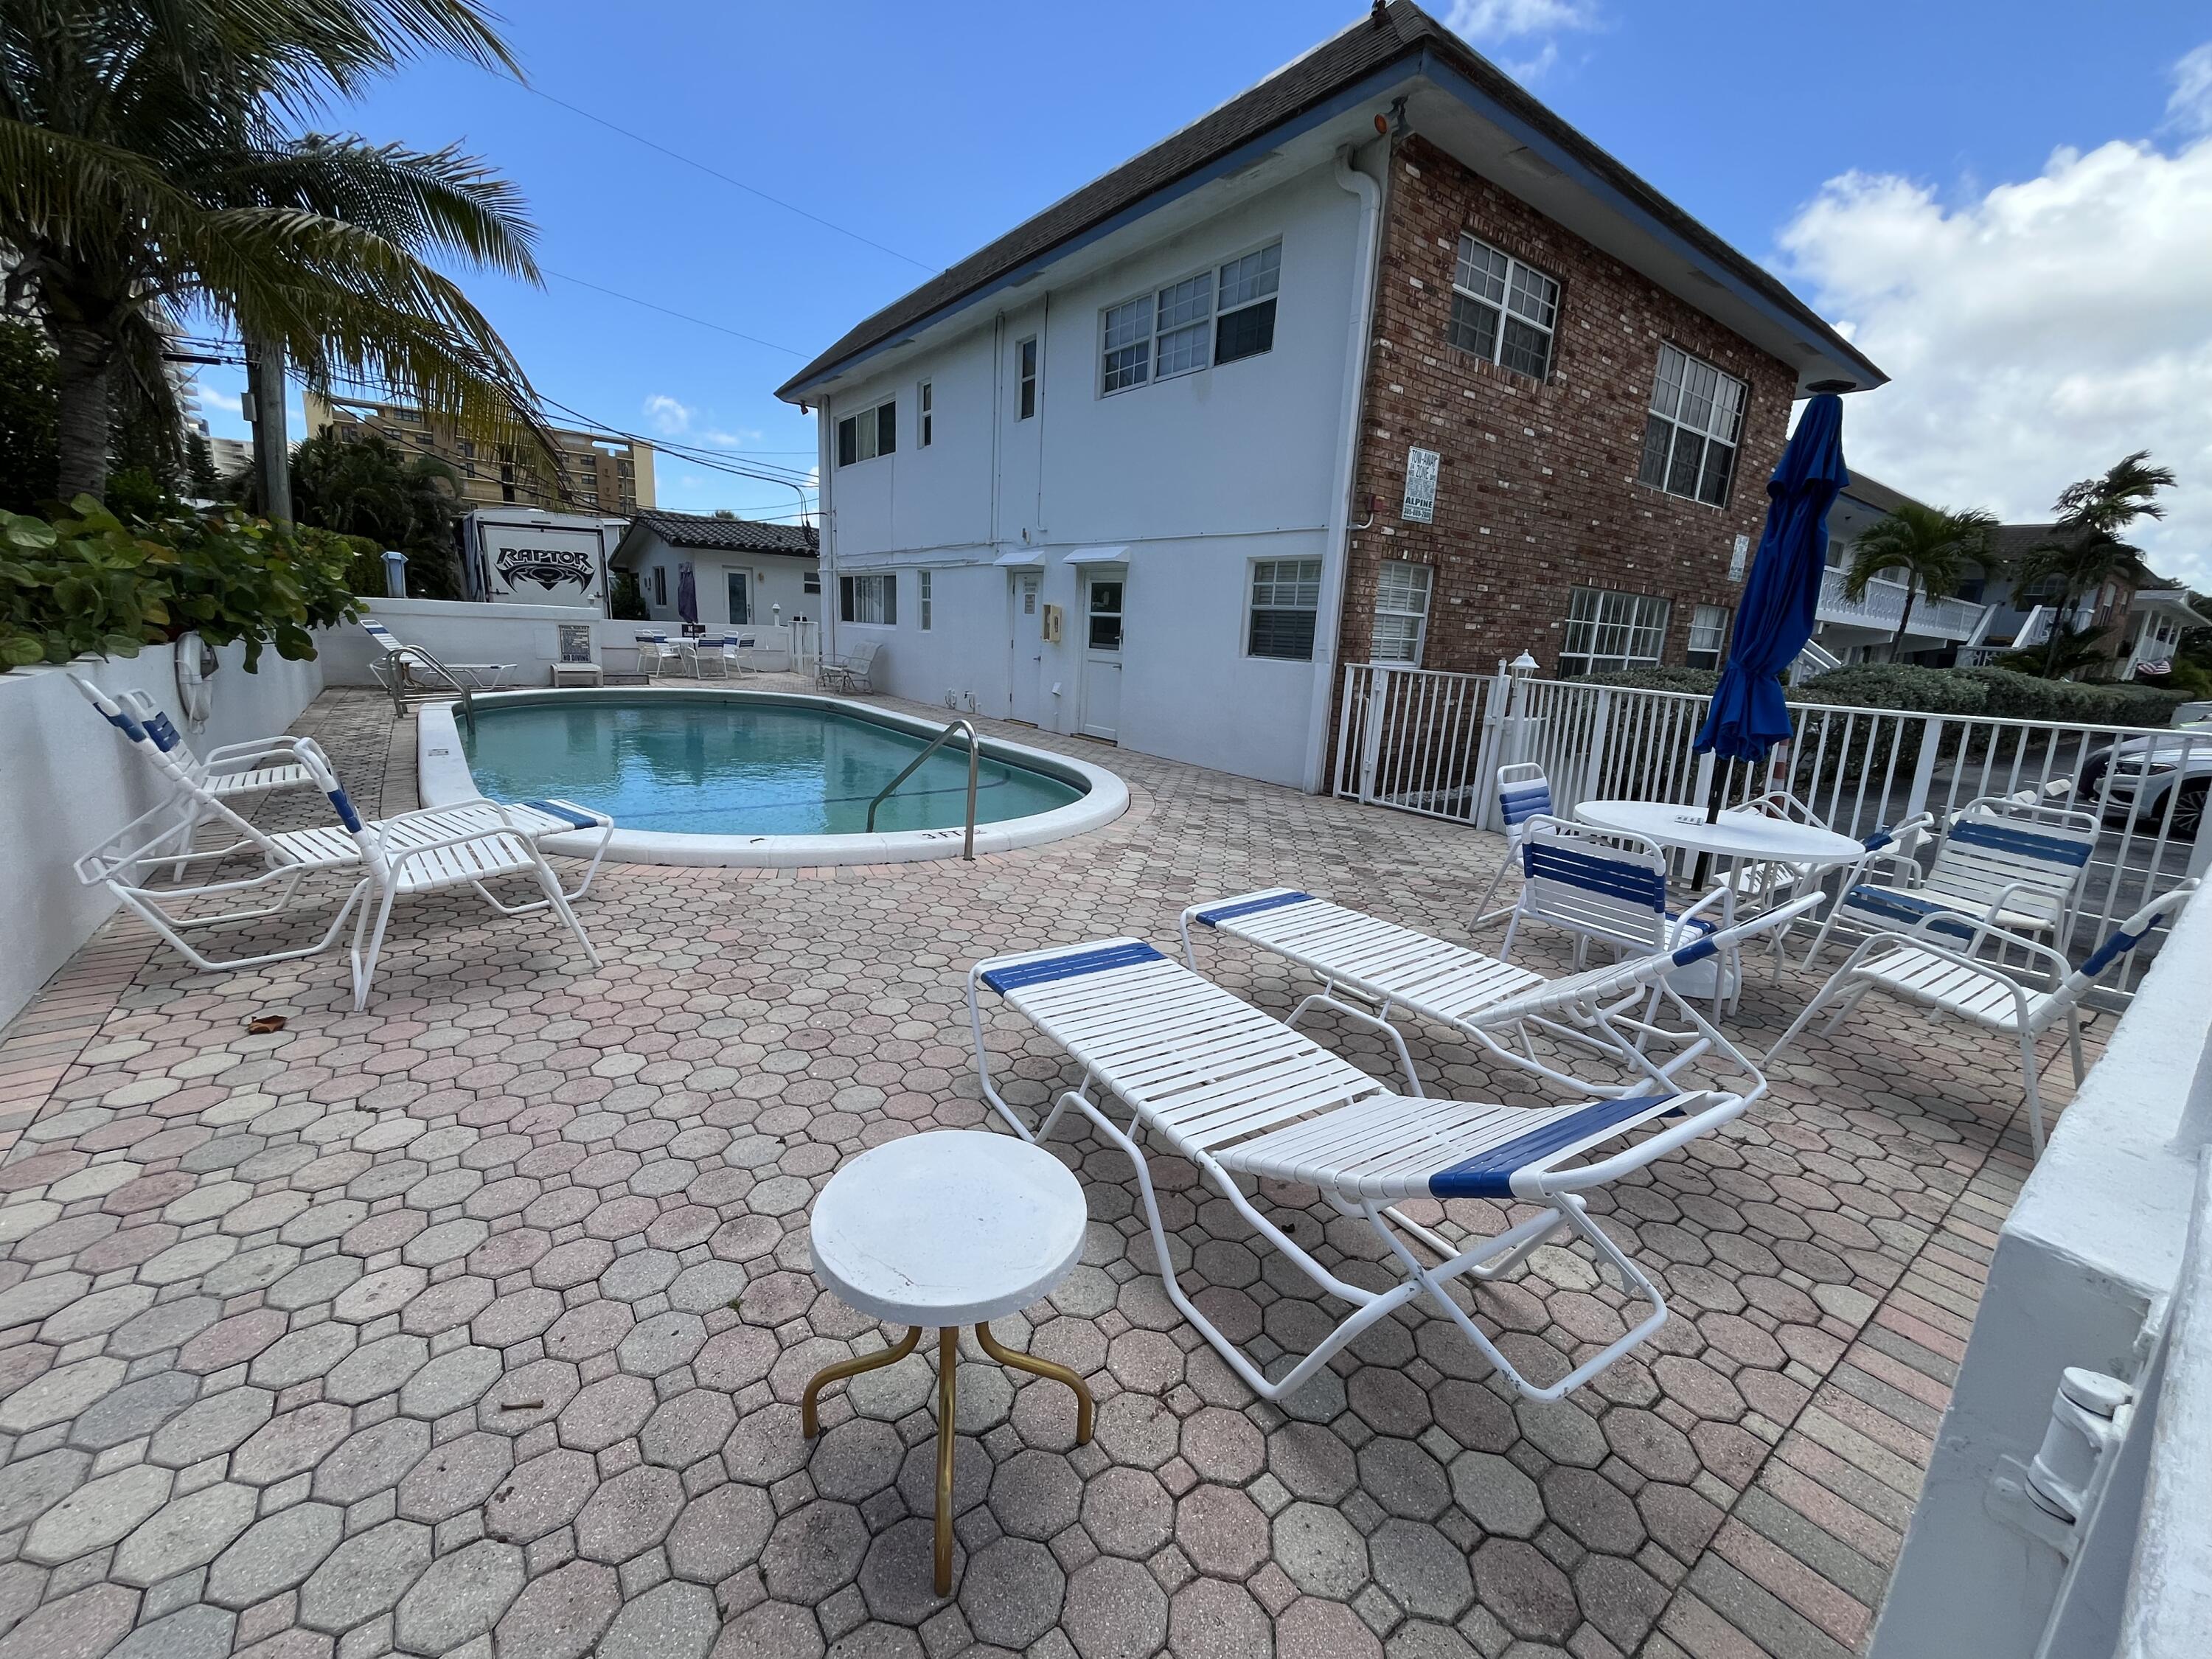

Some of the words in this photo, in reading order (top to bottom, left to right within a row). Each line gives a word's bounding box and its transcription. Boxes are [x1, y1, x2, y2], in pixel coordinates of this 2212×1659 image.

[1416, 465, 1429, 479] ZONE
[1405, 496, 1433, 508] ALPINE
[496, 547, 594, 568] RAPTOR
